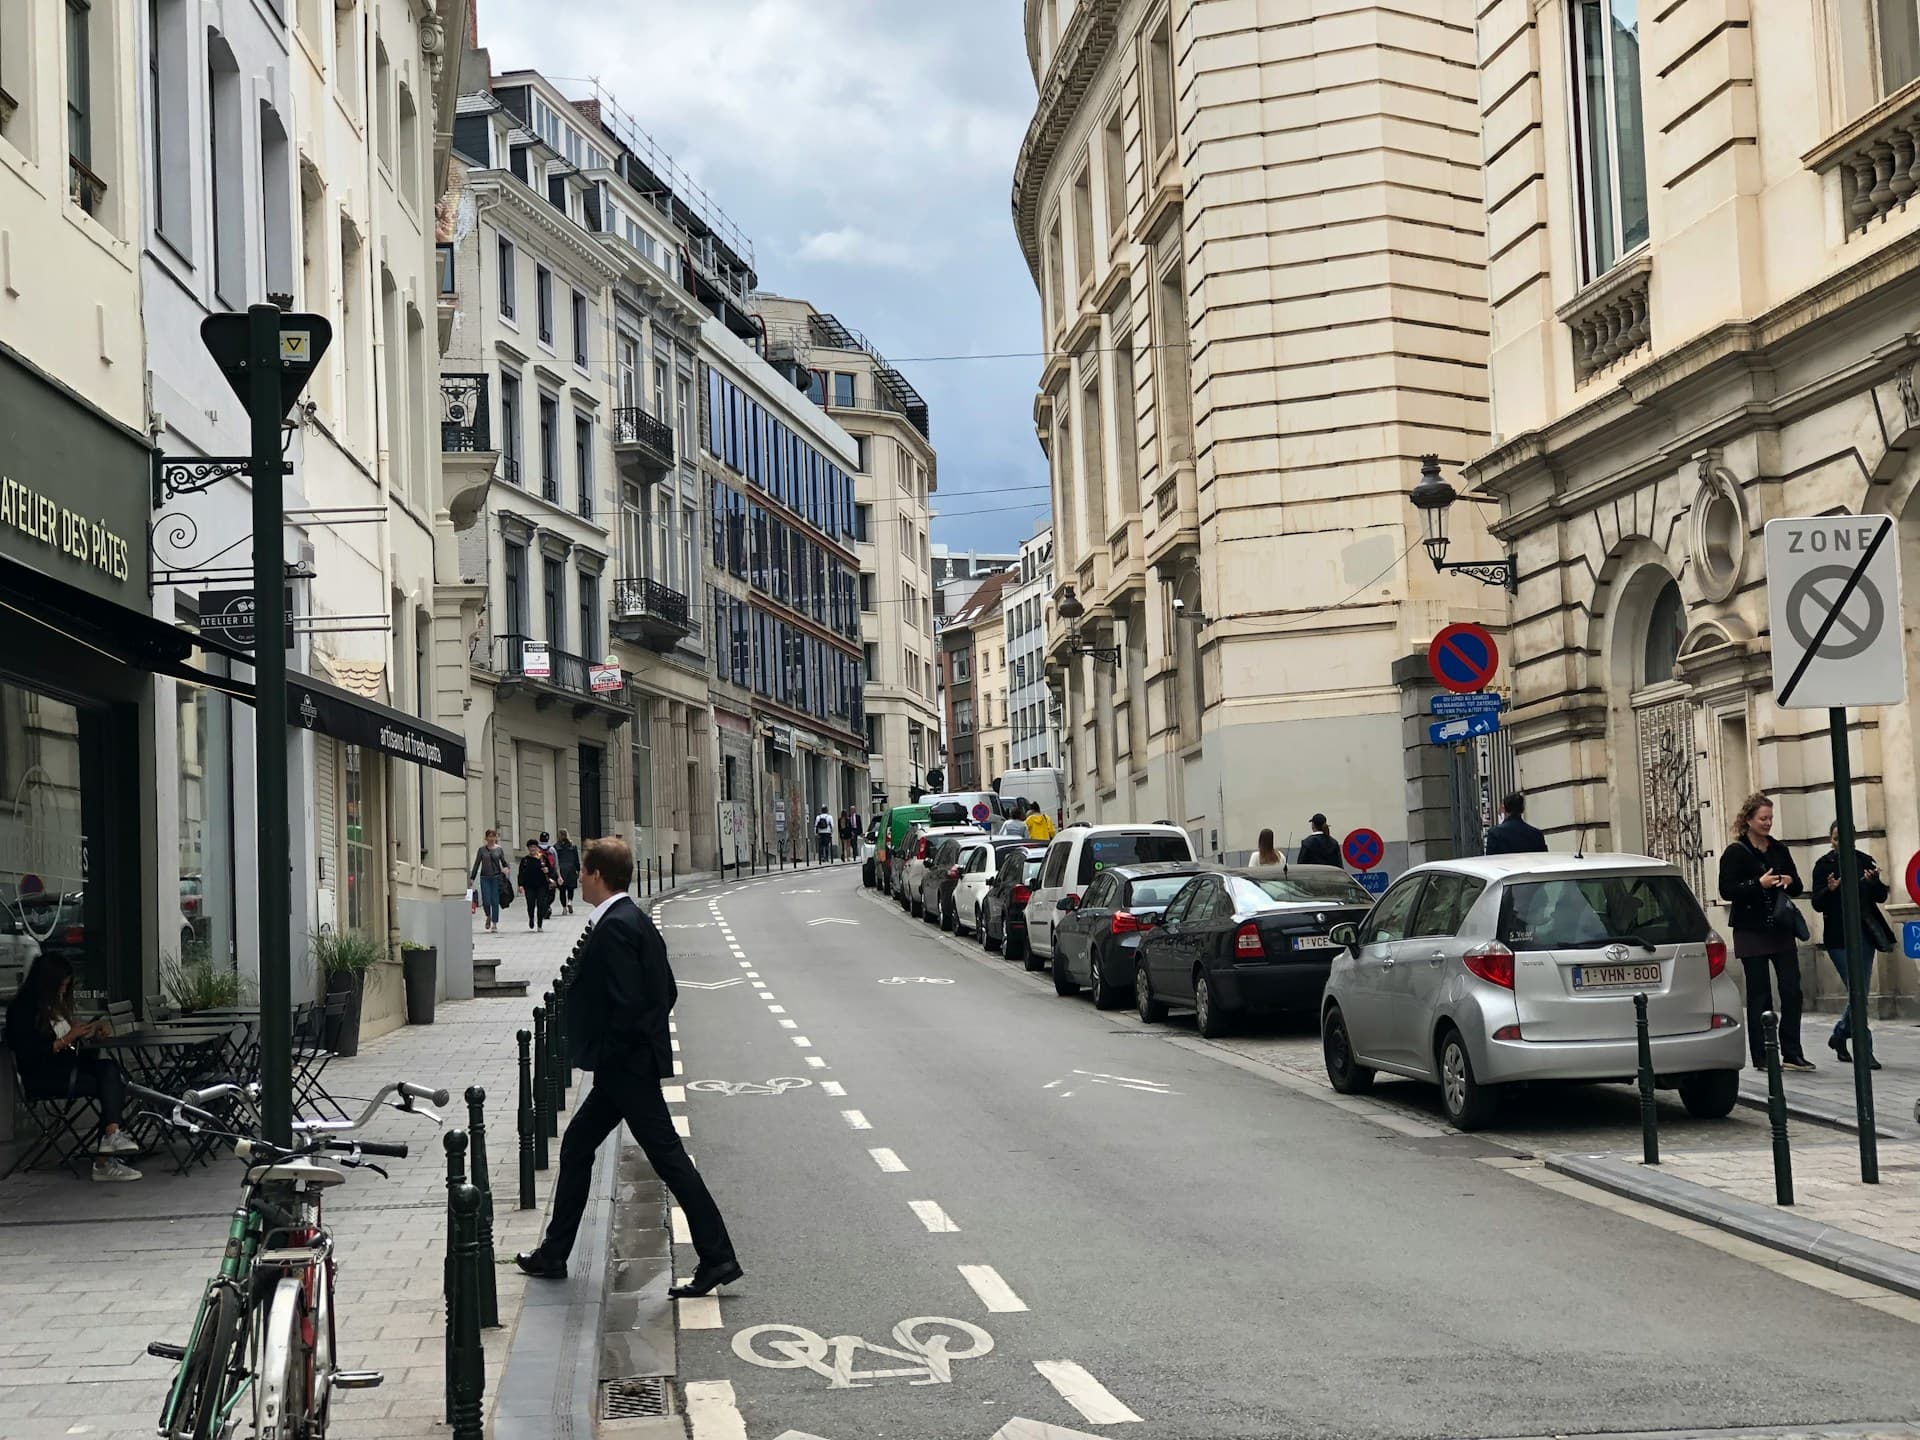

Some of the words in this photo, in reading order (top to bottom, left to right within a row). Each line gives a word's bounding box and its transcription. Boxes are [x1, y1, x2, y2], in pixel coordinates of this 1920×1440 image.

[1, 476, 57, 547] ATELIER
[62, 507, 88, 560] DES
[92, 518, 128, 581] PÂTES
[1787, 528, 1873, 553] ZONE
[200, 616, 238, 626] ATELIER
[243, 615, 255, 625] DE
[404, 731, 411, 754] of
[411, 732, 427, 758] fresh
[1300, 937, 1329, 948] 1-VCE
